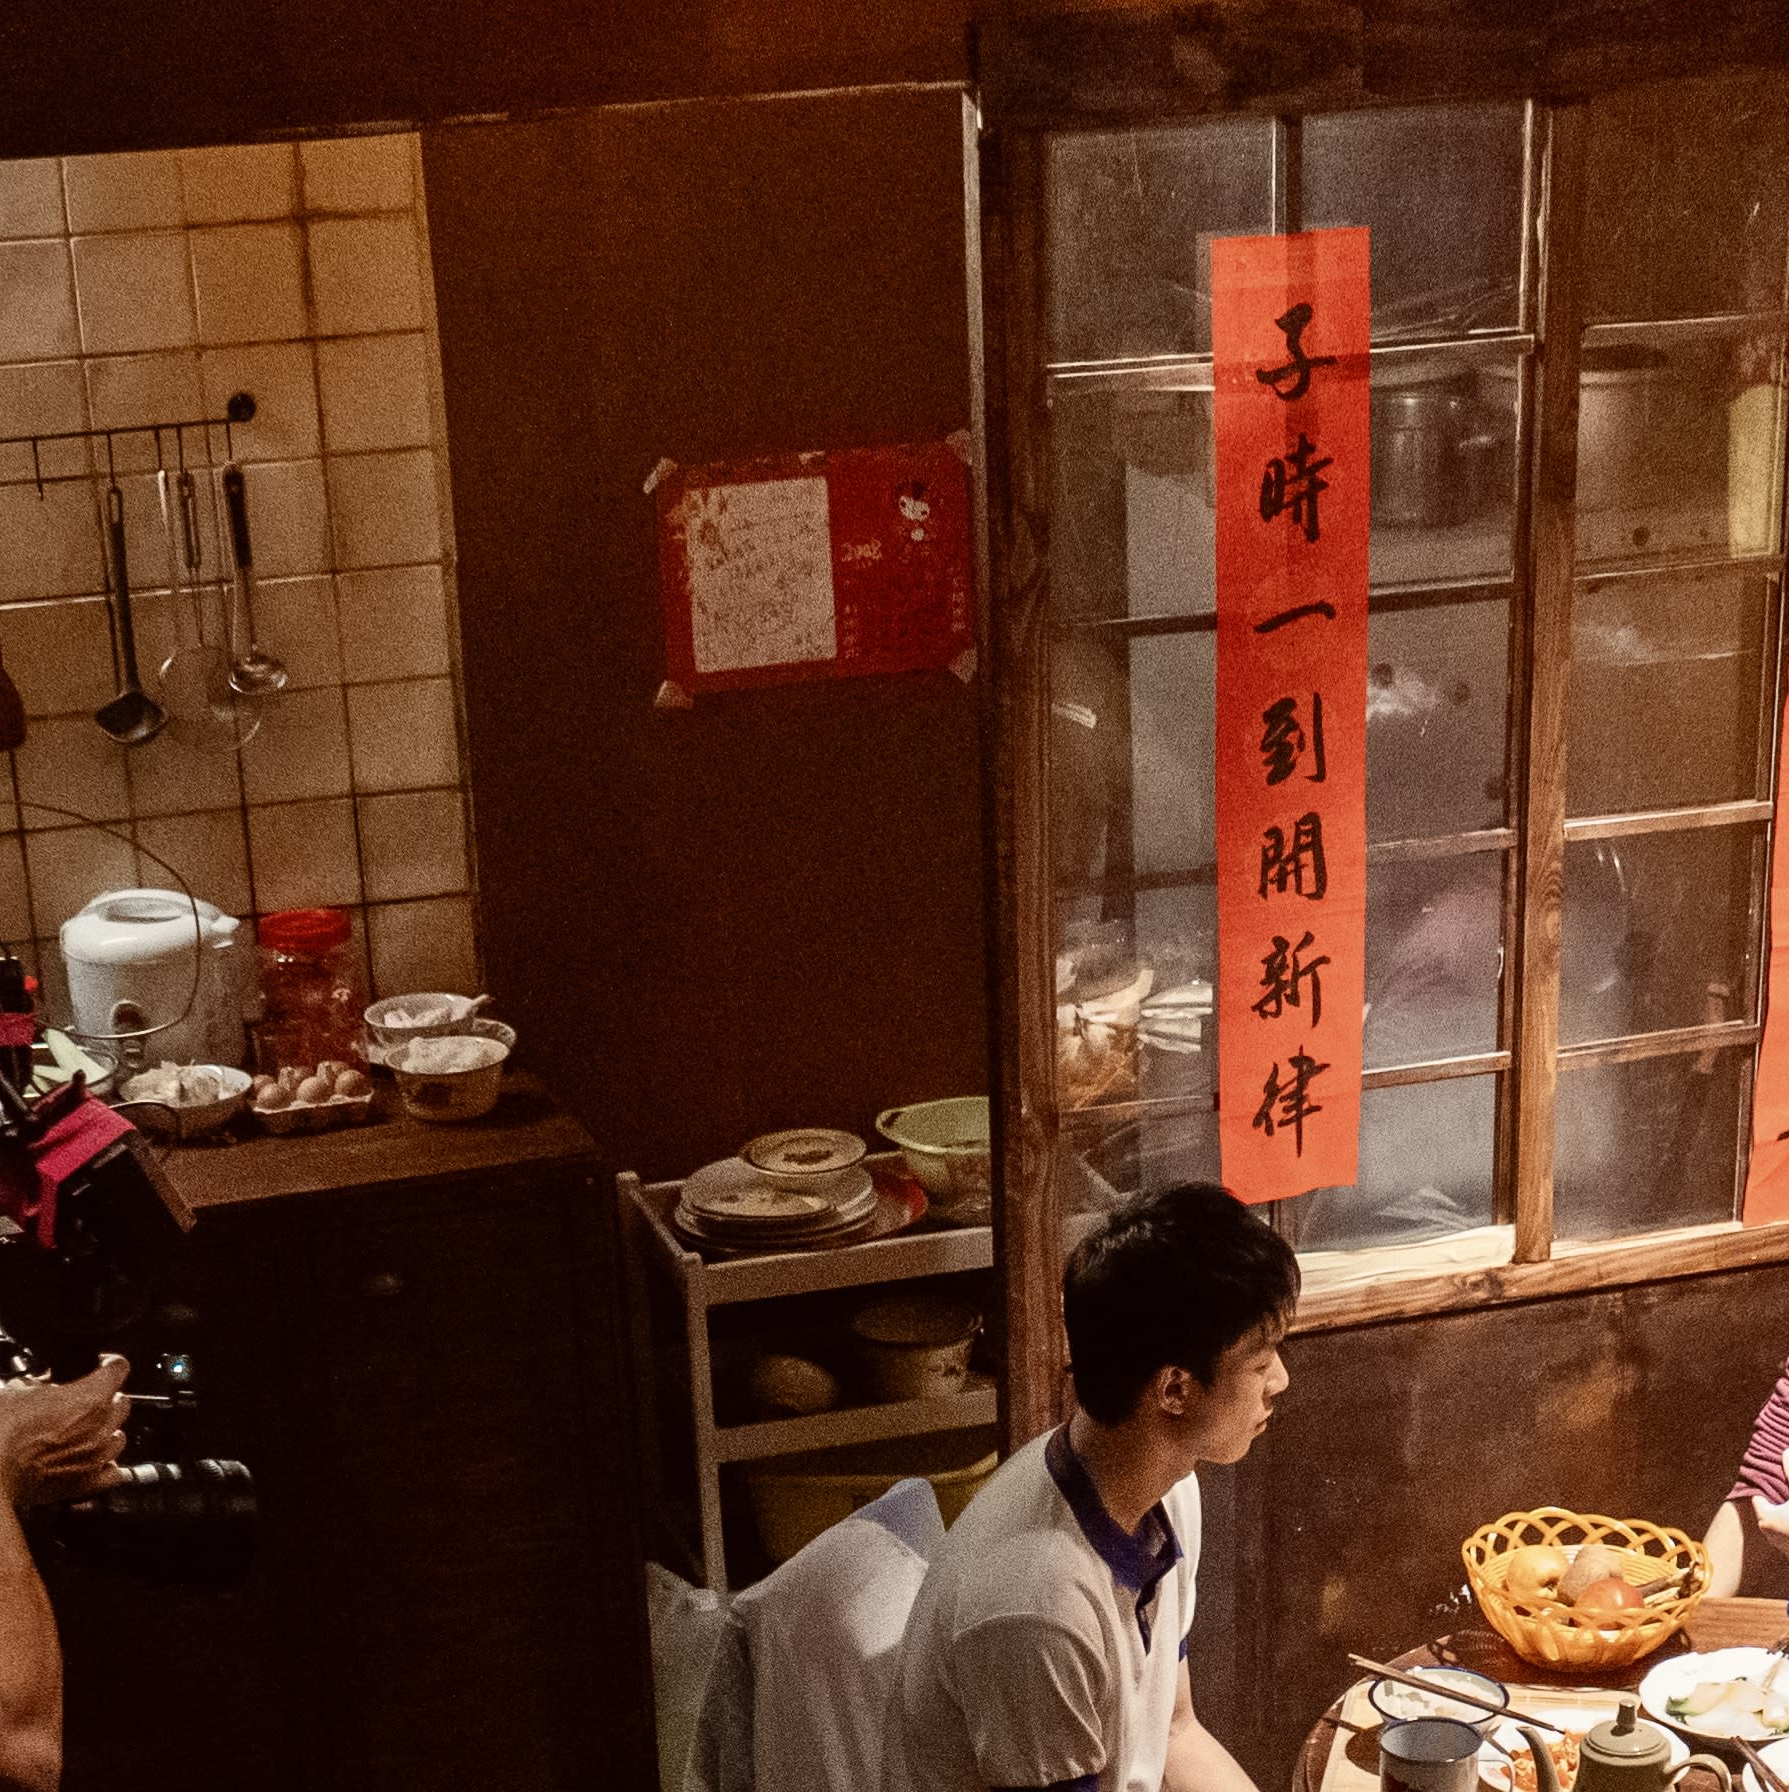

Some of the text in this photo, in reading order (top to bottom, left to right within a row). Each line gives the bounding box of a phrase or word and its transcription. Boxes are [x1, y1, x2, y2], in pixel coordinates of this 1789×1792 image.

[1250, 303, 1337, 1157] 子時一到開新律
